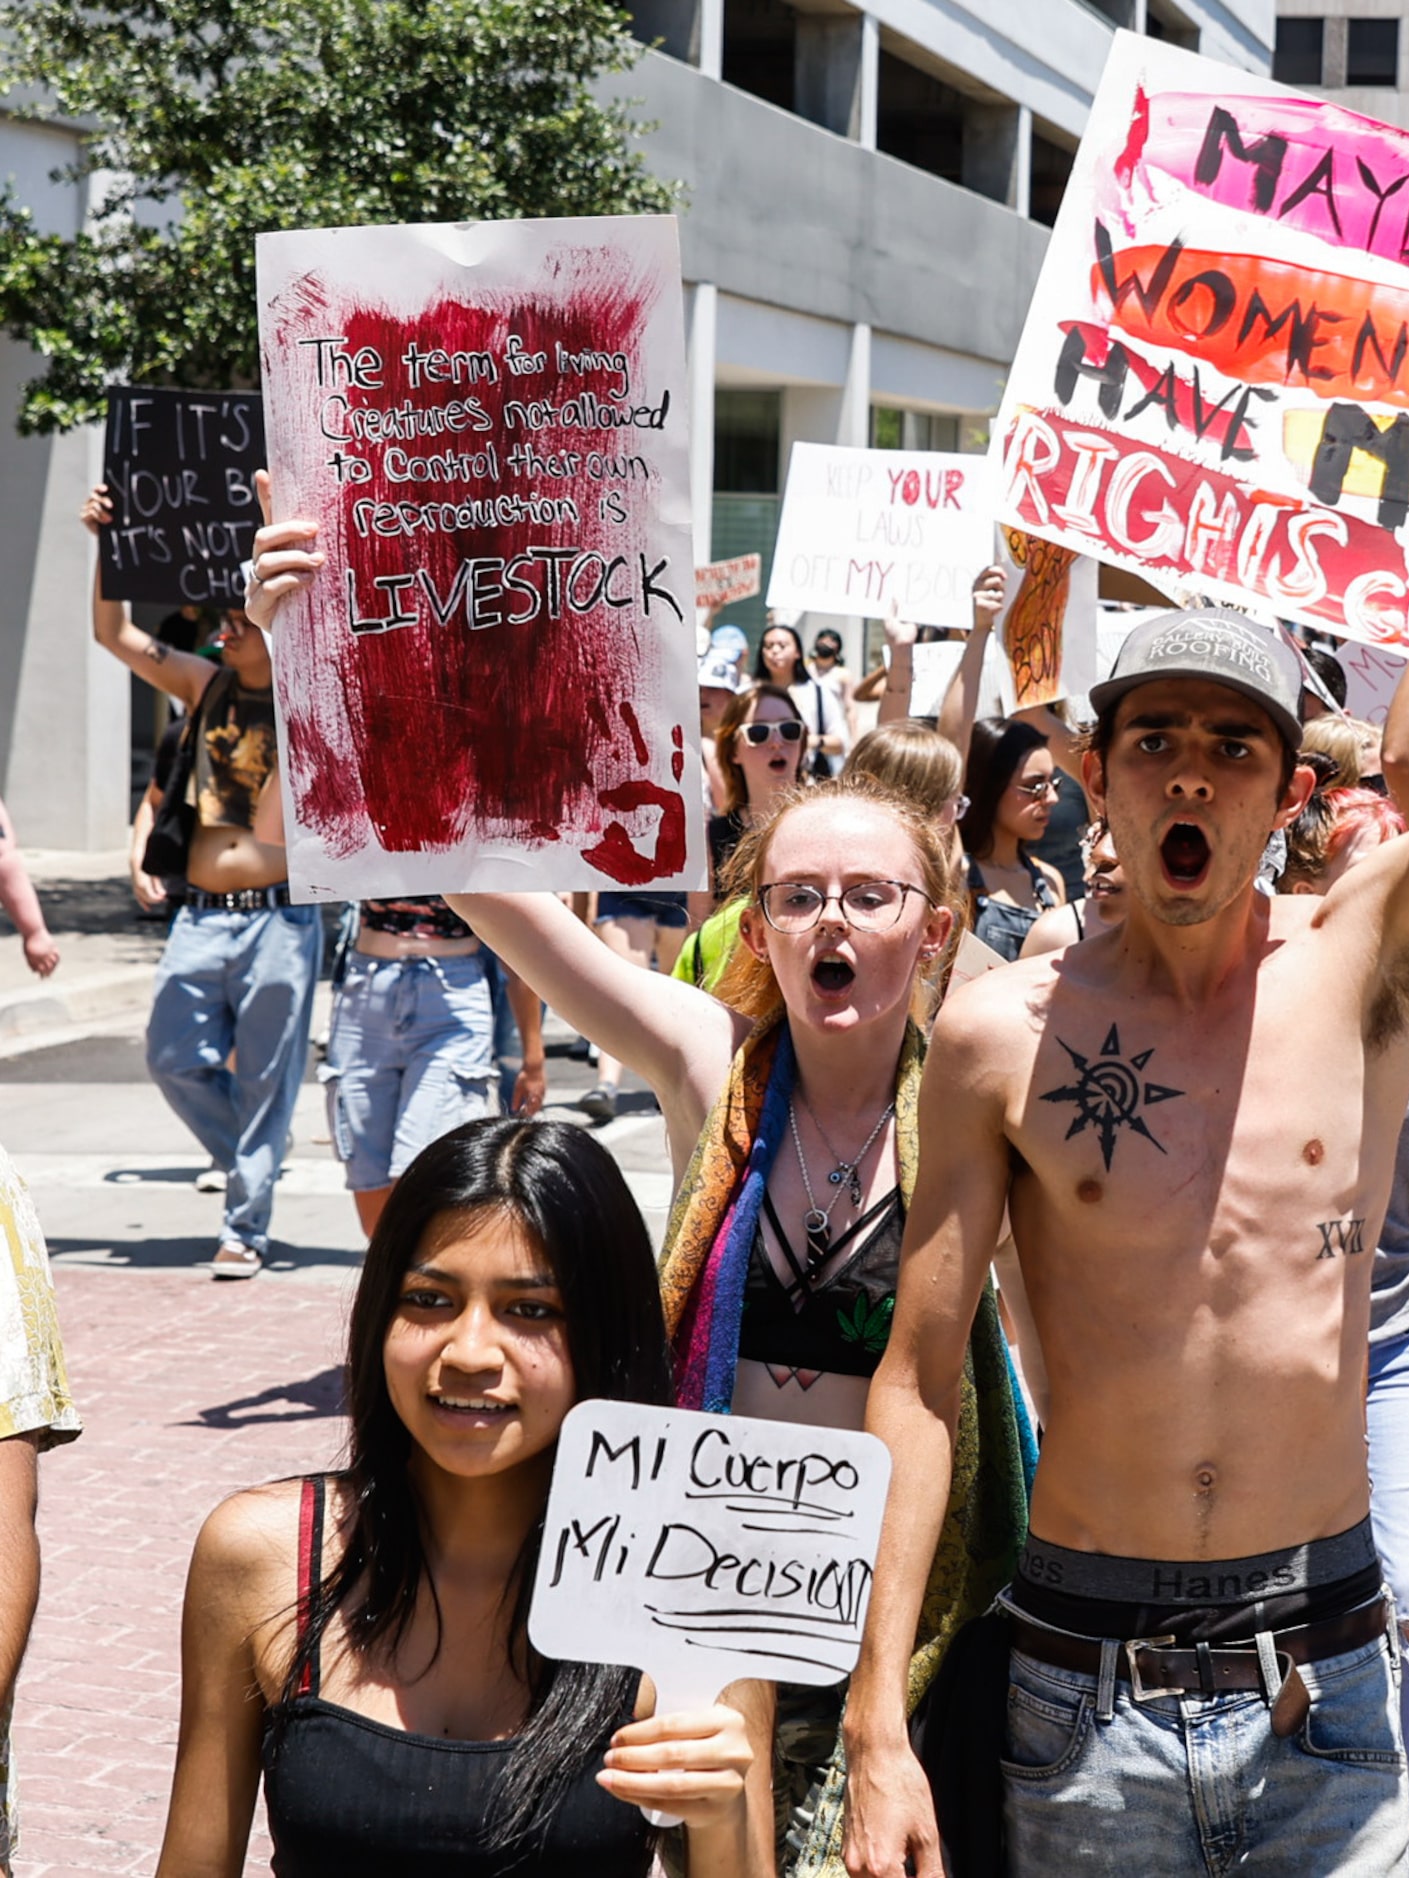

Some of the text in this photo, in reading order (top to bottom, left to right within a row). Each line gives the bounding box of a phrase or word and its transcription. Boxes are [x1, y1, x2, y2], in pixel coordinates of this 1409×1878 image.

[1095, 217, 1408, 384] WOMEN
[299, 335, 629, 398] The term for living
[1053, 325, 1279, 462] HAVE
[113, 399, 250, 460] IF IT'S
[320, 389, 670, 443] Creatures not allowed
[327, 451, 370, 484] to
[507, 443, 581, 479] their
[587, 455, 650, 480] own
[887, 467, 966, 511] YOUR
[106, 460, 257, 526] YOUR B
[354, 494, 580, 538] reproduction
[1001, 408, 1349, 608] RIGHTS
[111, 520, 253, 570] IT'S NOT
[856, 509, 926, 548] LAWS
[345, 546, 684, 636] LIVESTOCK
[789, 553, 839, 592] OFF
[844, 557, 896, 602] MY
[1149, 641, 1272, 682] ROOFING
[1315, 1219, 1366, 1260] XVII
[691, 1428, 859, 1510] Cuerpo
[645, 1523, 873, 1629] Decision
[1151, 1562, 1296, 1601] Hanes
